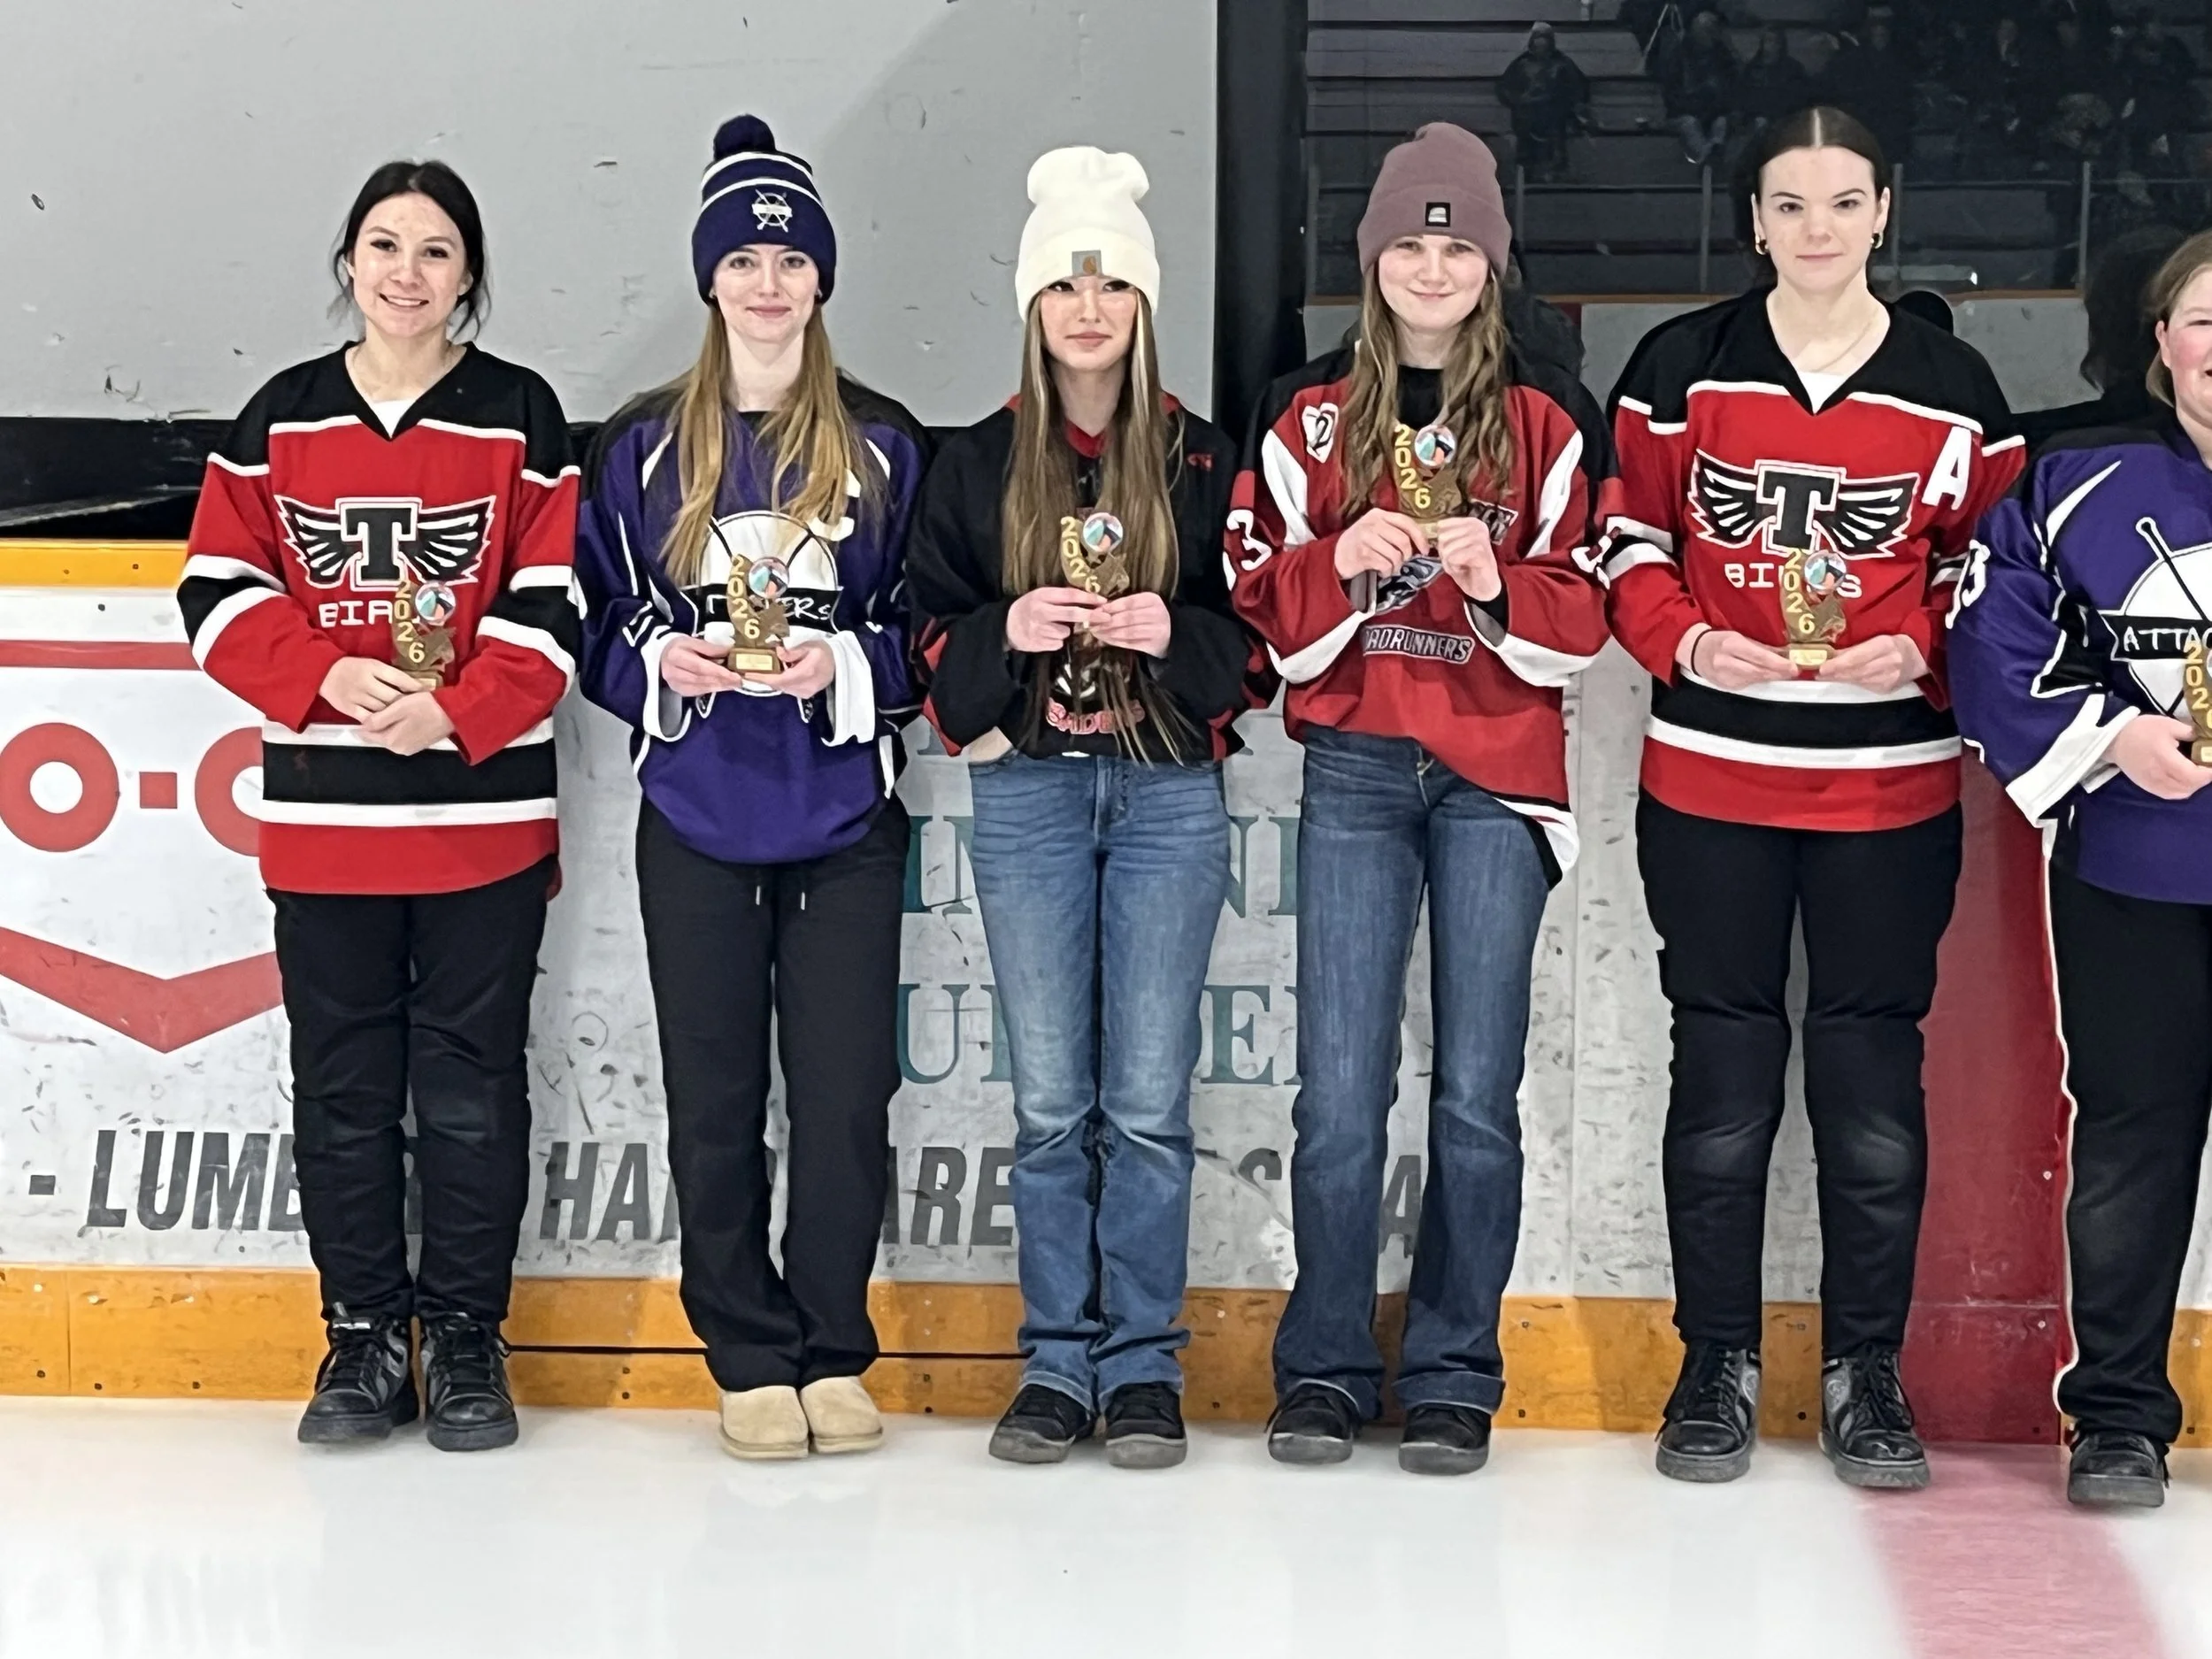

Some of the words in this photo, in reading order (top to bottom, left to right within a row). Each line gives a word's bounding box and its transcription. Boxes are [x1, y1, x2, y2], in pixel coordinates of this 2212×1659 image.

[1394, 424, 1431, 510] 2026
[1921, 426, 1973, 511] A
[725, 554, 762, 640] 2026
[1060, 516, 1102, 595] 2026
[1782, 548, 1816, 634] 2026
[395, 580, 426, 664] 2026
[1364, 628, 1471, 662] ADRUNNERS
